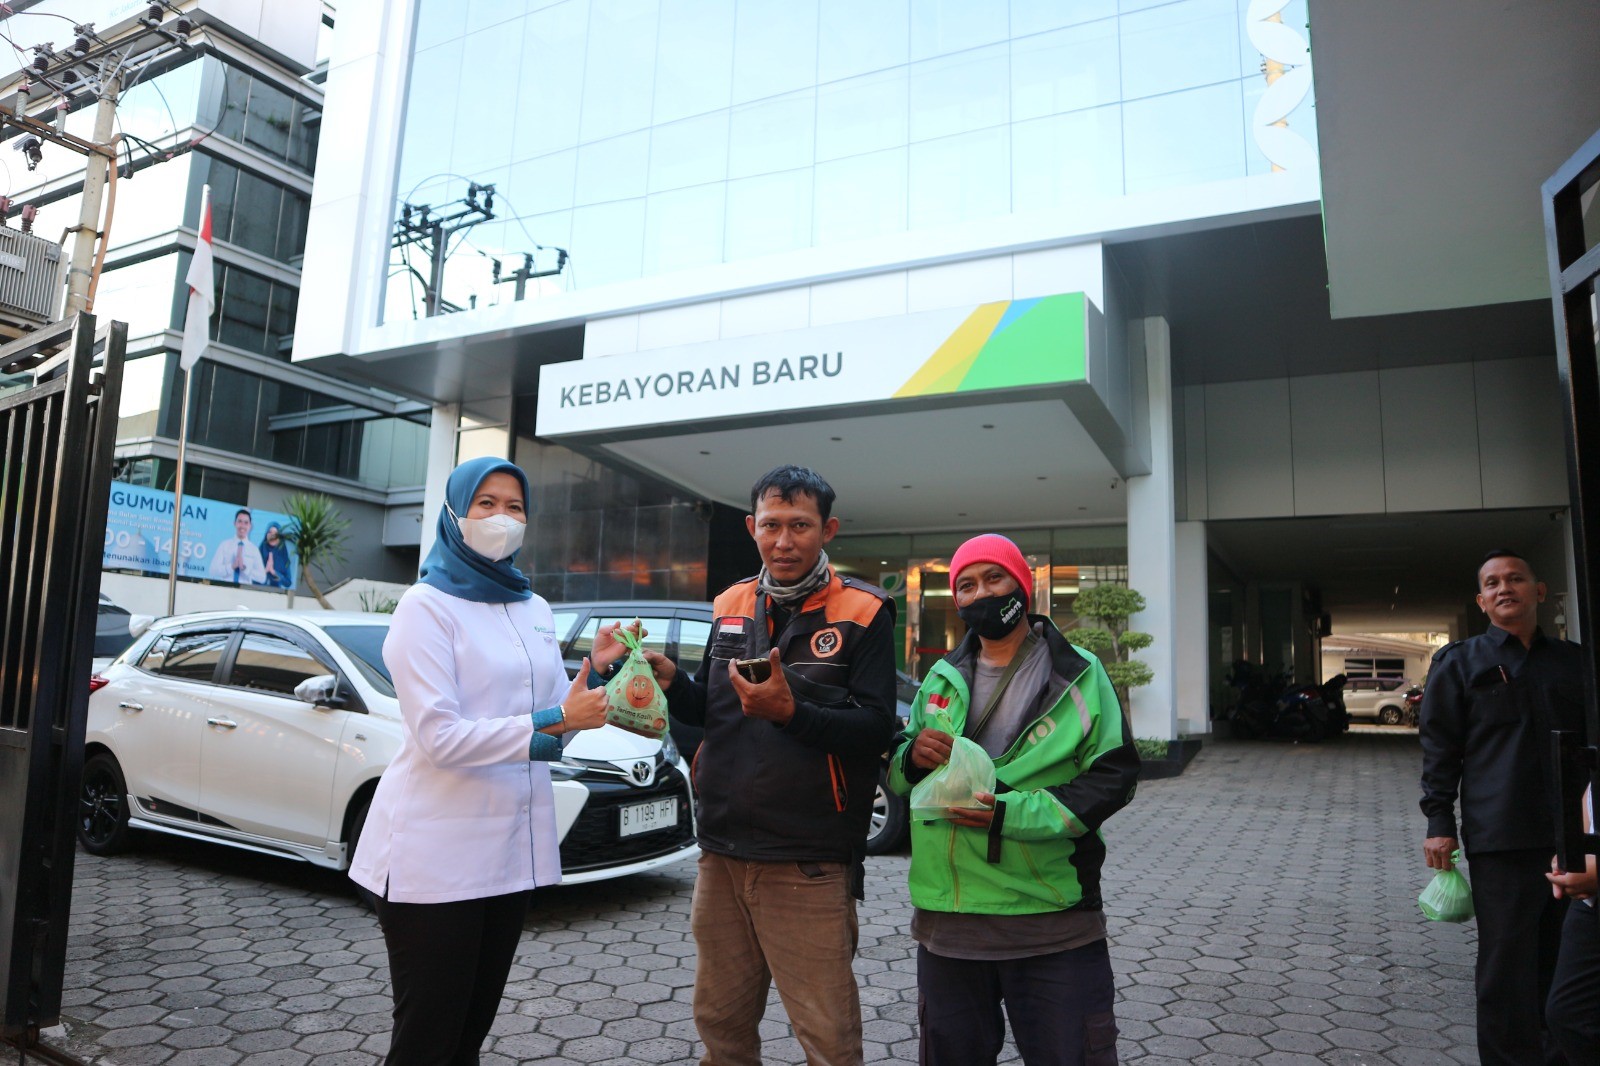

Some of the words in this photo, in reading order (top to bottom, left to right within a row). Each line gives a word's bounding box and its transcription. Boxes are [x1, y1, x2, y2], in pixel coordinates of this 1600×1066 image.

[560, 364, 740, 408] KEBAYORAN
[752, 352, 843, 385] BARU
[153, 535, 207, 559] 1430
[623, 809, 629, 826] B
[636, 804, 655, 823] 1199
